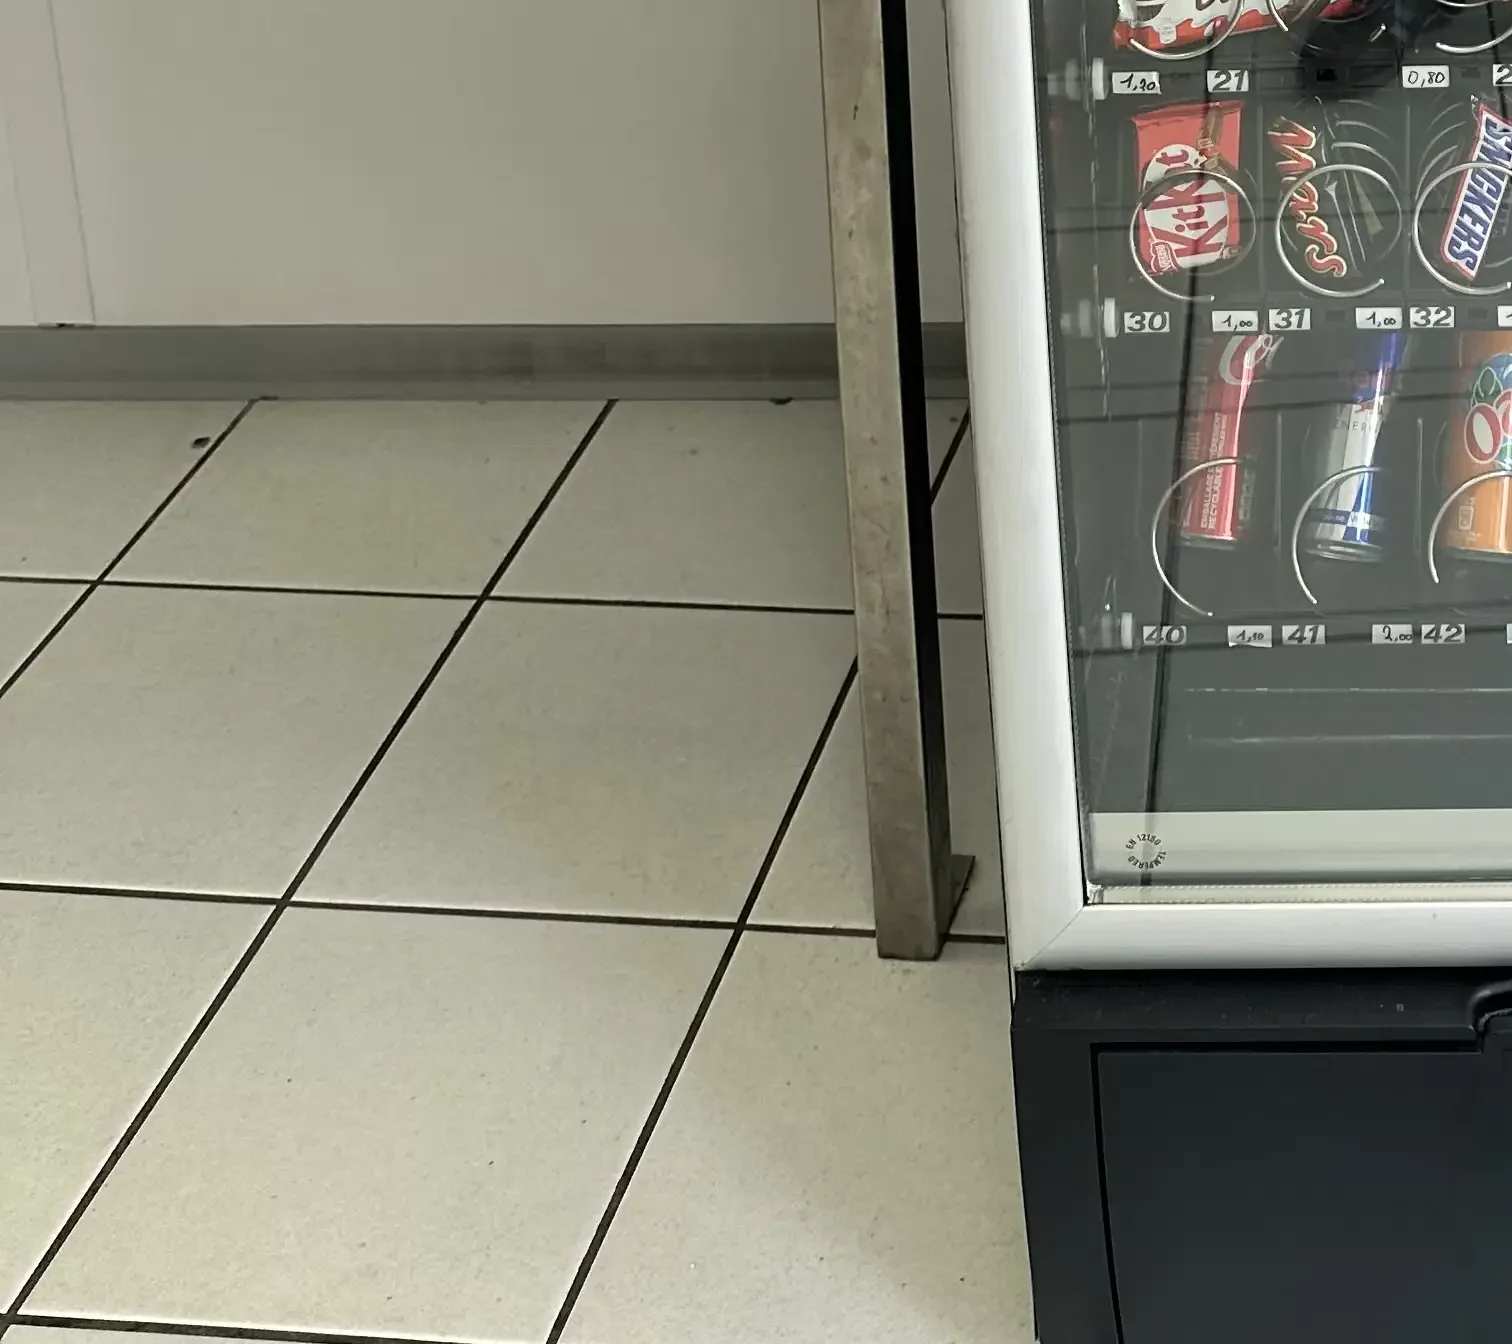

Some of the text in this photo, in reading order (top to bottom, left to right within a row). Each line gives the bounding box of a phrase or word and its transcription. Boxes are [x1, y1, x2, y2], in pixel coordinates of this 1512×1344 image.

[1212, 70, 1247, 90] 21
[1128, 313, 1168, 332] 30
[1271, 310, 1308, 329] 31
[1412, 308, 1453, 326] 32
[1145, 626, 1185, 644] 40
[1287, 625, 1321, 643] 41
[1424, 625, 1463, 643] 42
